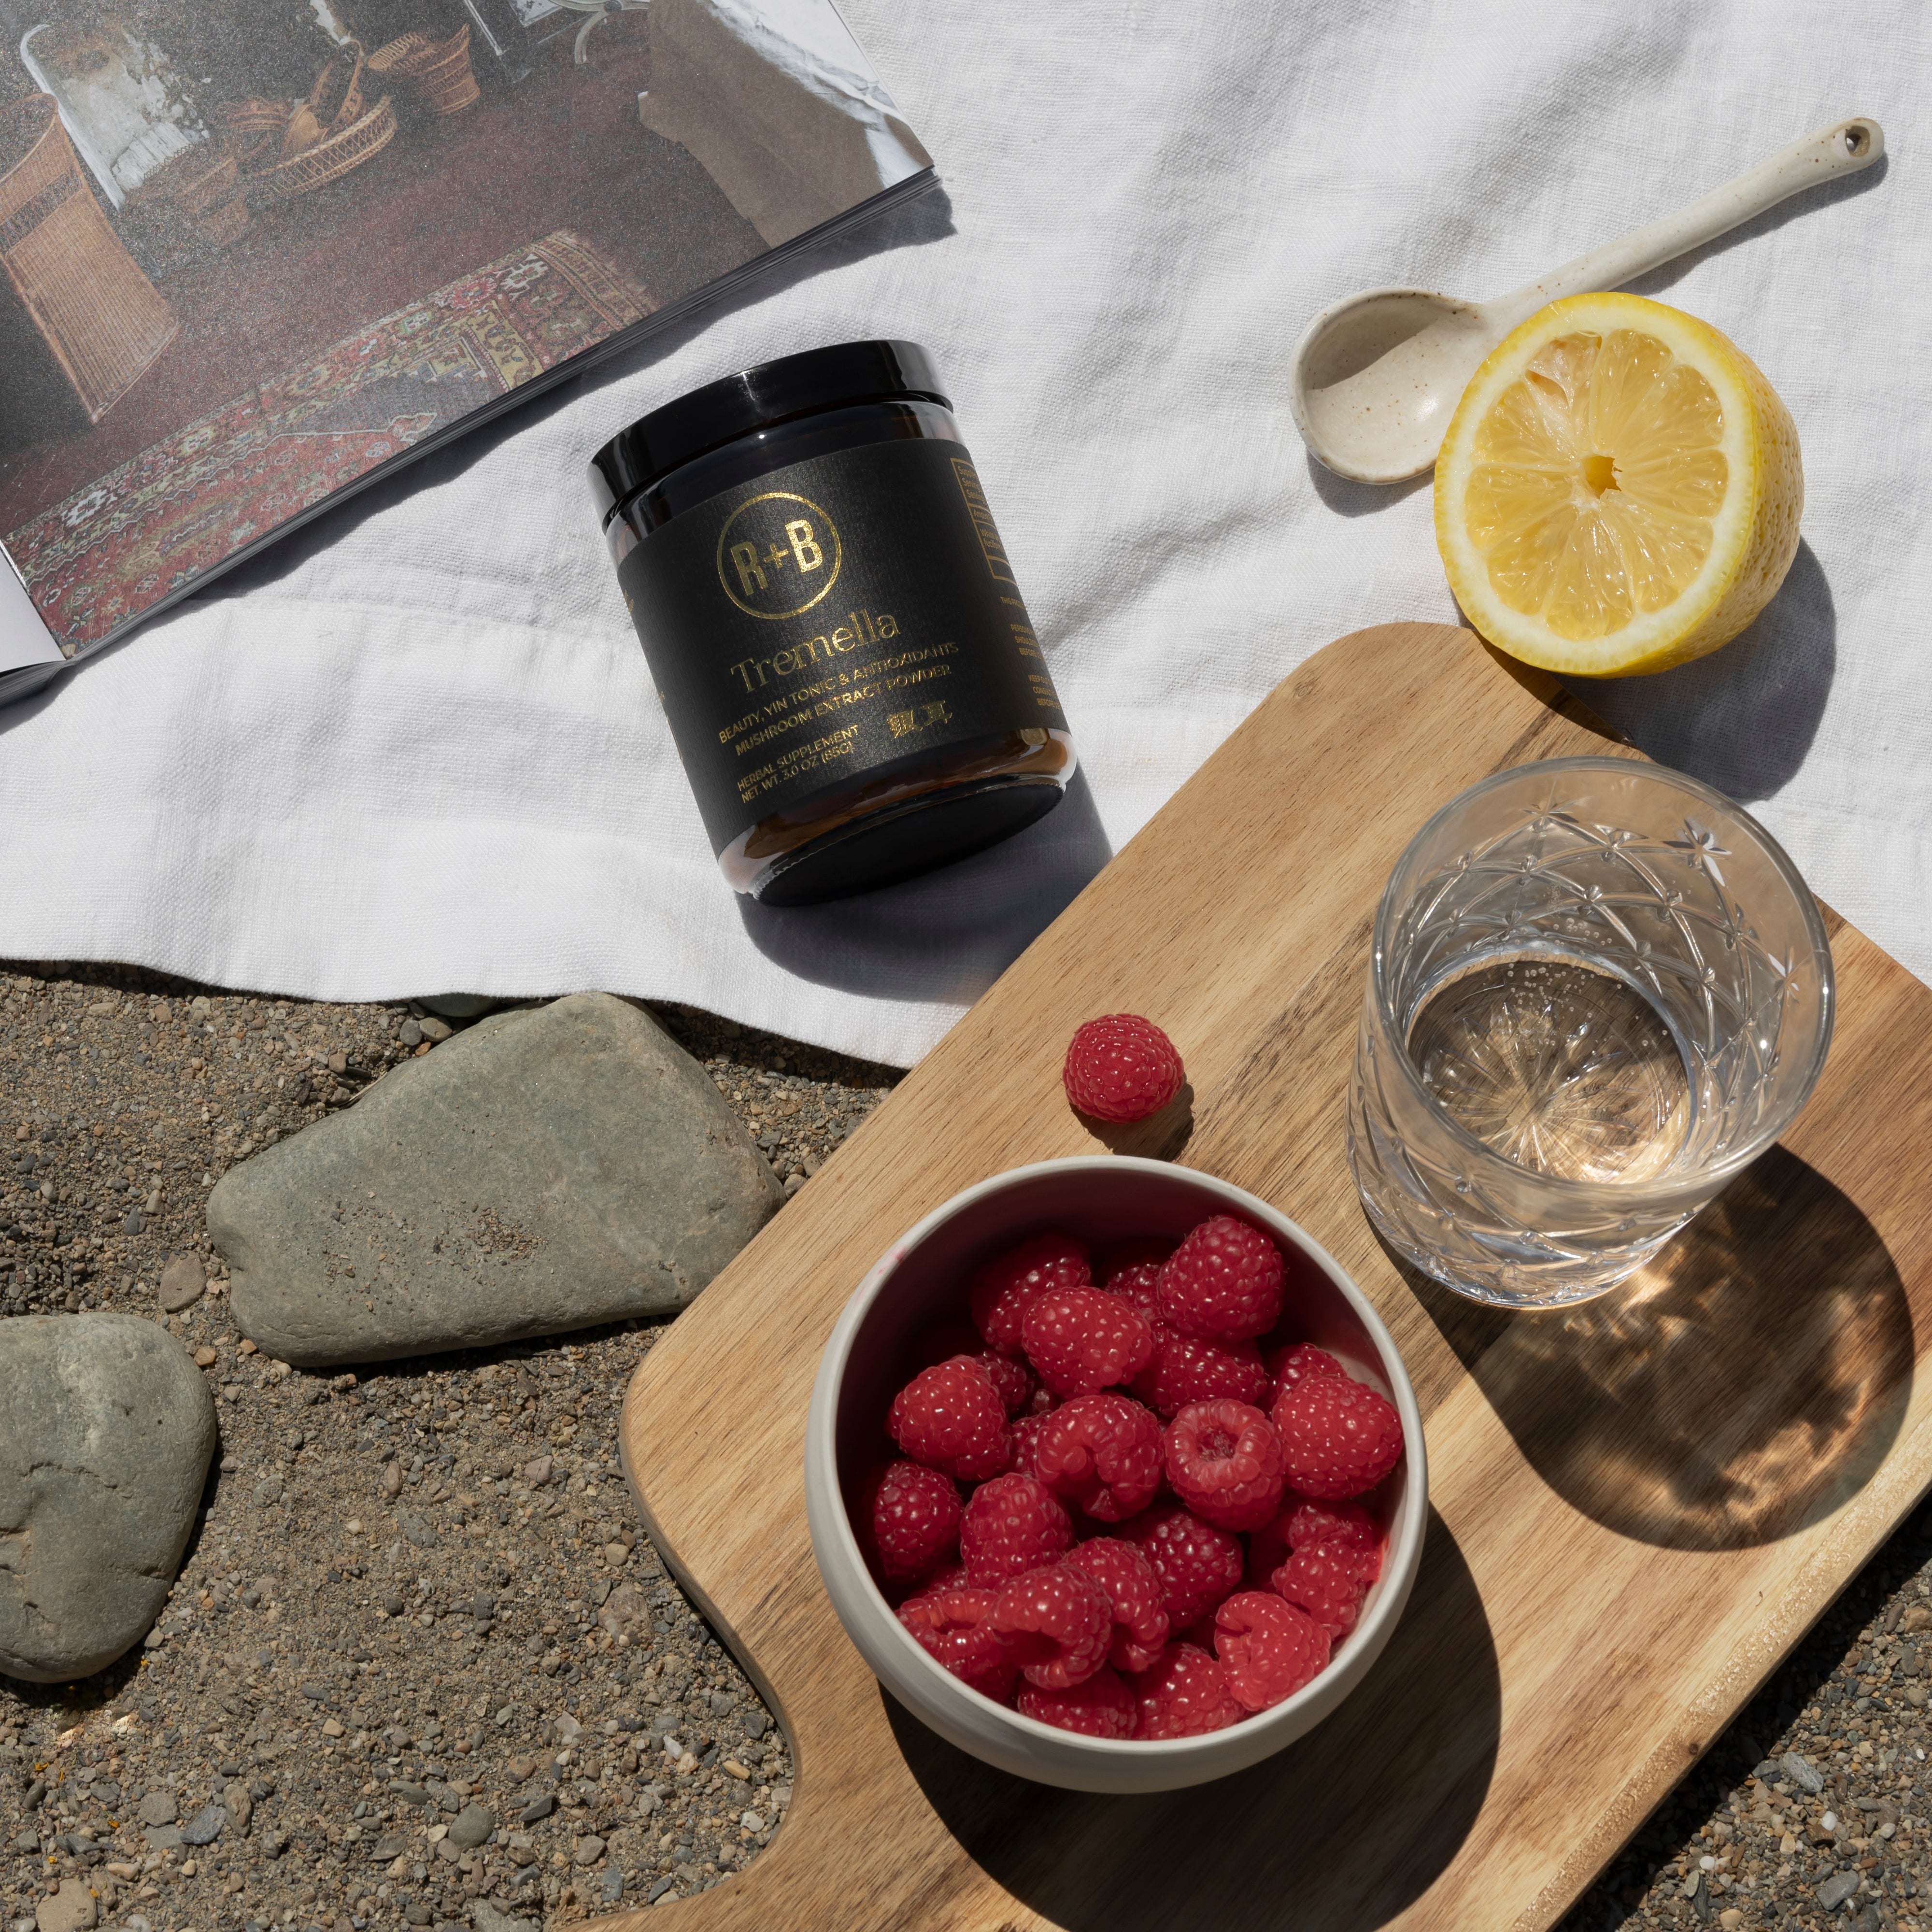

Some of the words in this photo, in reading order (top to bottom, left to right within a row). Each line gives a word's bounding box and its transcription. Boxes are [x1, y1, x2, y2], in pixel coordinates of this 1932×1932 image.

[730, 519, 823, 596] R+B
[730, 608, 901, 694] Tremella
[719, 711, 765, 744] BEAUTY,
[764, 697, 788, 716] YIN
[789, 678, 836, 705] TONIC
[838, 673, 850, 686] &
[853, 641, 959, 682] ANTIOXIDANTS
[735, 708, 813, 756] MUSHROOM
[815, 682, 882, 717] EXTRACT
[886, 664, 952, 690] POWDER
[737, 763, 776, 792] HERBAL
[777, 724, 859, 769] SUPPLEMENT
[741, 786, 762, 803] NET.
[761, 772, 782, 791] WT.
[783, 765, 798, 780] 3.0
[800, 754, 819, 771] OZ
